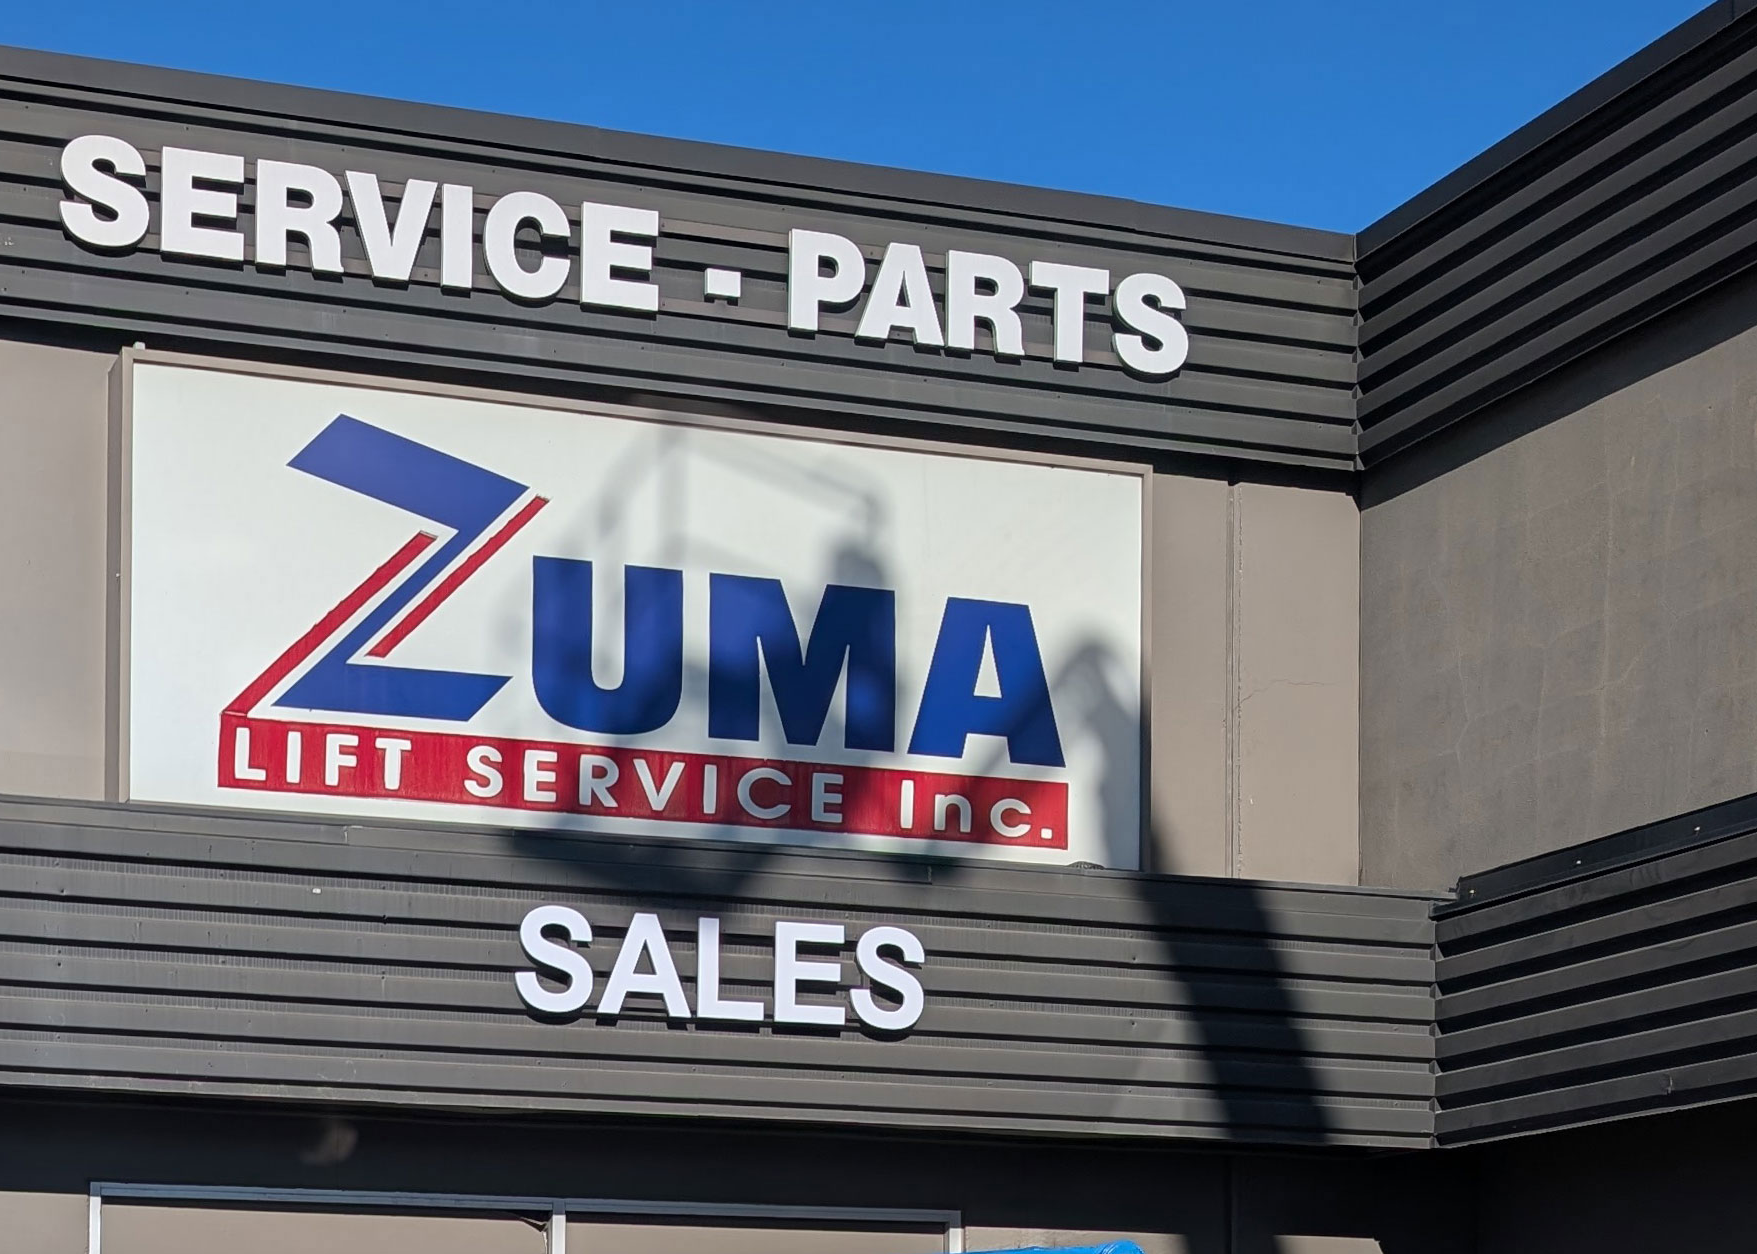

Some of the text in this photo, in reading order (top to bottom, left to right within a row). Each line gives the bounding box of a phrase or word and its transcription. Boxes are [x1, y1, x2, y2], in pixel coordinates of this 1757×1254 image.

[60, 135, 659, 312] SERVICE
[790, 229, 1189, 374] PARTS
[274, 413, 1066, 768] ZUMA
[234, 727, 1053, 840] LIFT SERVICE Inc.
[515, 906, 925, 1030] SALES
